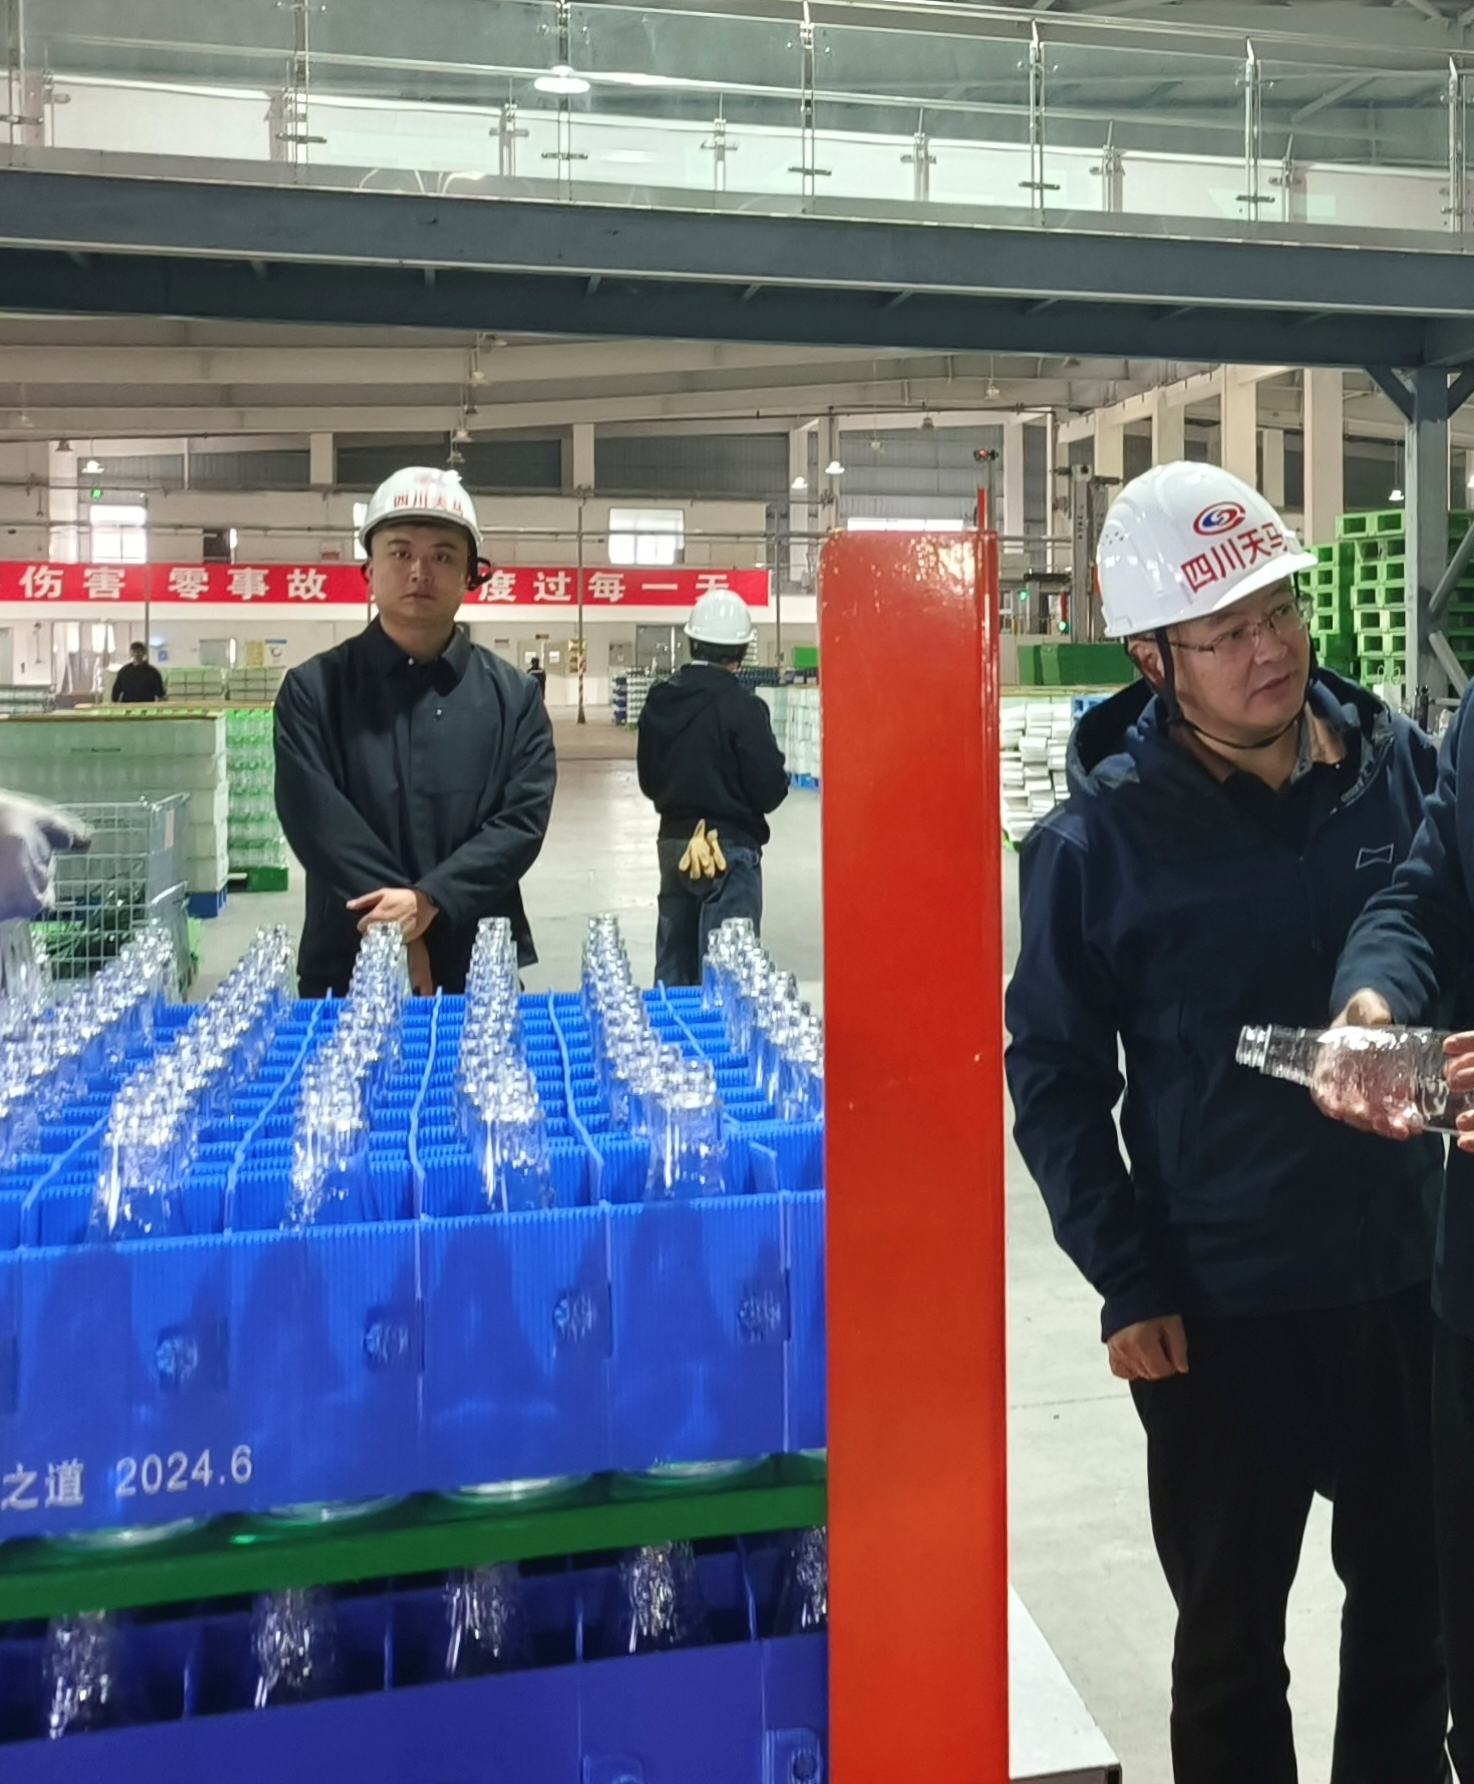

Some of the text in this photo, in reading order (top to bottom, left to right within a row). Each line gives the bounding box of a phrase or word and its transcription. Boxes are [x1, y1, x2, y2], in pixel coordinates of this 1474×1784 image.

[19, 565, 729, 603] 伤害 零事故 度过每一天
[1180, 522, 1288, 594] 四川天马
[1, 1444, 253, 1510] 之道 2024.6
